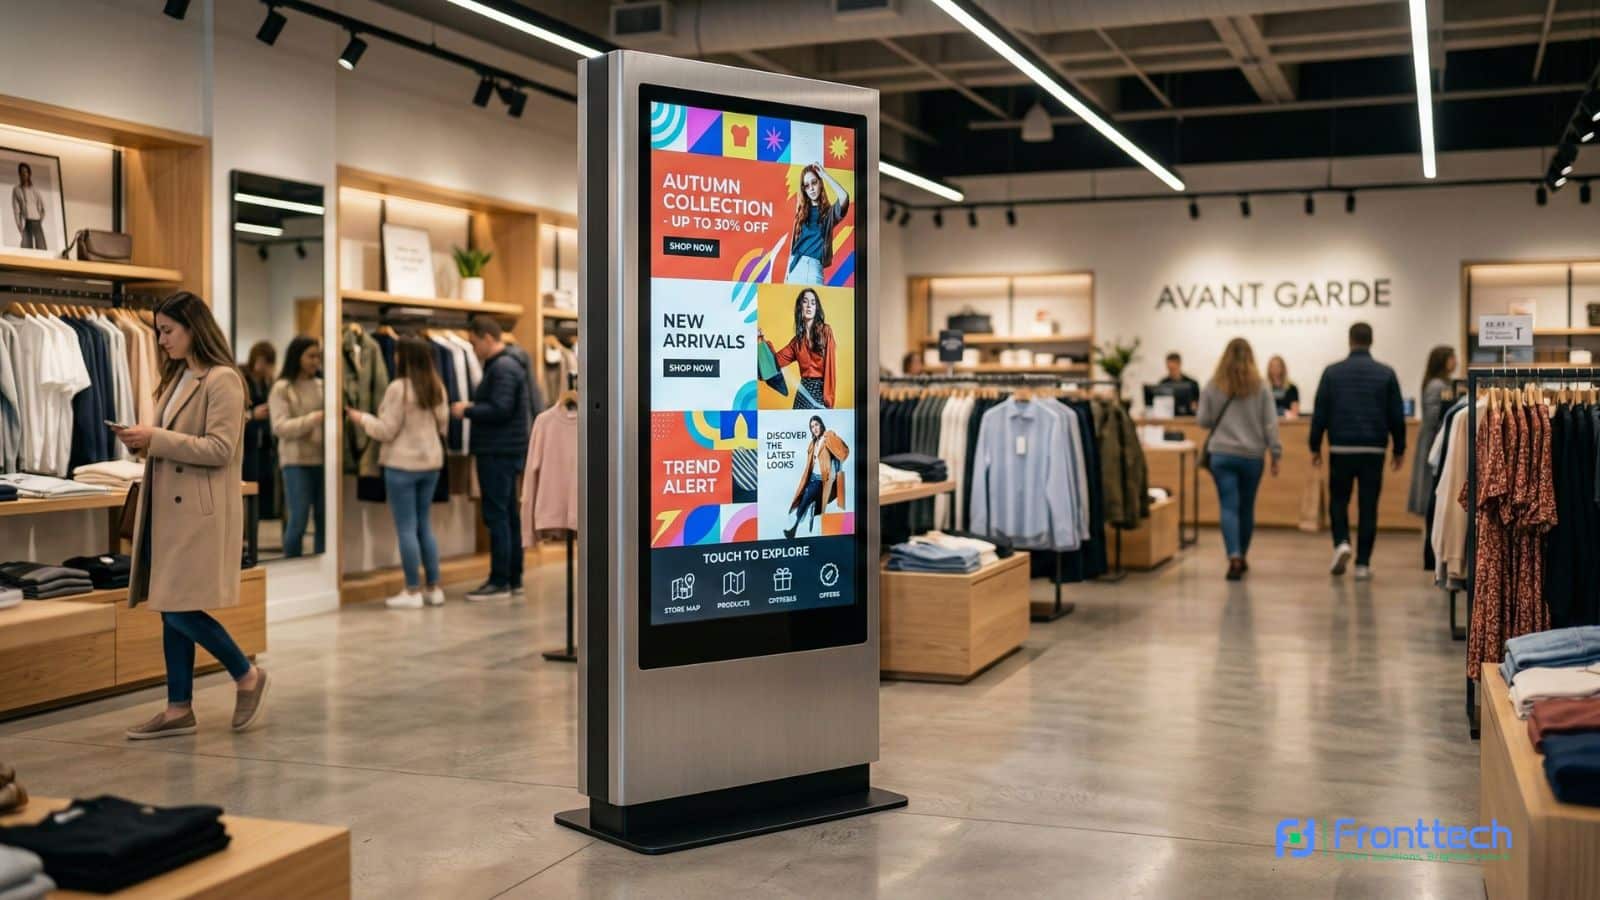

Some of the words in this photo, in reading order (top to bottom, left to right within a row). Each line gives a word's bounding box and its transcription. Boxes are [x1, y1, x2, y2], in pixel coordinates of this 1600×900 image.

[663, 172, 741, 195] AUTUMN
[663, 193, 774, 217] COLLECTION
[671, 214, 690, 228] UP
[693, 216, 712, 230] TO
[714, 217, 741, 232] 30%
[743, 220, 769, 233] OFF
[669, 241, 692, 251] SHOP
[693, 243, 714, 253] NOW
[1155, 283, 1264, 310] AVANT
[1273, 278, 1392, 309] GARDE
[663, 313, 705, 329] NEW
[663, 333, 745, 350] ARRIVALS
[669, 364, 692, 372] SHOP
[693, 364, 714, 372] NOW
[766, 431, 807, 440] DISCOVER
[767, 442, 783, 450] THE
[766, 451, 795, 460] LATEST
[663, 459, 721, 476] TREND
[766, 461, 794, 470] LOOKS
[663, 478, 717, 495] ALERT
[703, 550, 742, 564] TOUCH
[744, 549, 760, 561] TO
[762, 546, 810, 559] EXPLORE
[664, 606, 685, 614] STORE
[686, 604, 701, 612] MAP
